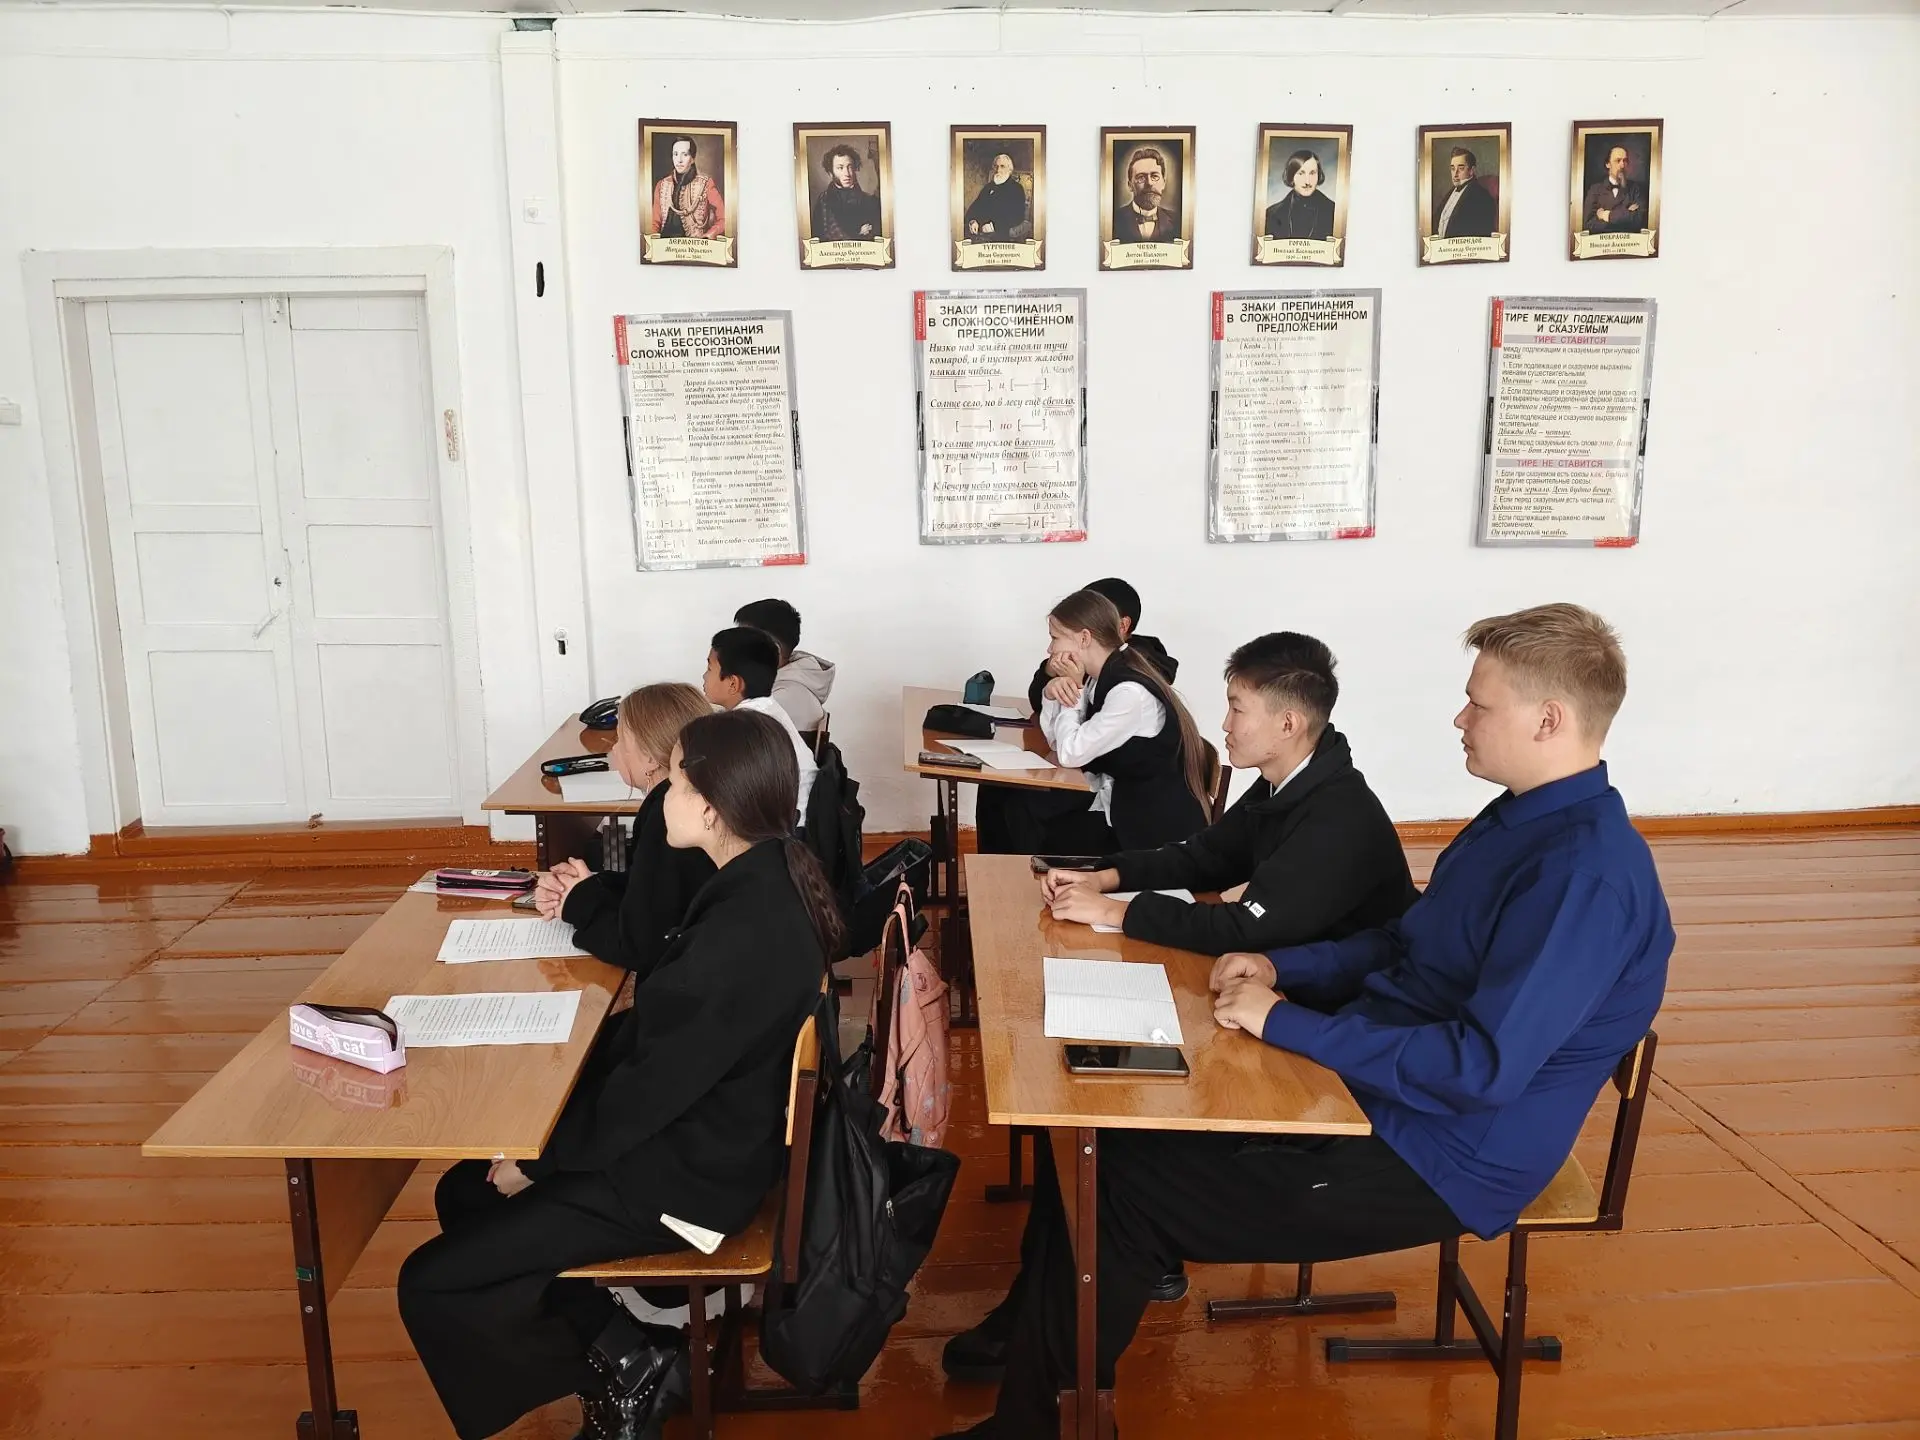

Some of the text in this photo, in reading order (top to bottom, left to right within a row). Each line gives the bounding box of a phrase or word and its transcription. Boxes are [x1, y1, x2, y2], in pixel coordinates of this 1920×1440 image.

[939, 304, 1062, 315] ЗНАКИ ПРЕПИНАНИЯ
[1241, 300, 1354, 311] ЗНАКИ ПРЕПИНАНИЯ
[928, 314, 1074, 327] В СЛОЖНОСОЧИНЁННОМ
[1227, 309, 1368, 323] В СЛОЖНОПОДЧИНЁННОМ
[1505, 313, 1644, 325] ТИРЕ МЕЖДУ ПОДЛЕЖАЩИМ
[644, 325, 764, 338] ЗНАКИ ПРЕПИНАНИЯ
[1256, 322, 1338, 333] ПРЕДЛОЖЕНИИ
[1536, 324, 1609, 334] И СКАЗУЕМЫМ
[957, 328, 1045, 339] ПРЕДЛОЖЕНИИ
[657, 336, 753, 348] В БЕССОЮЗНОМ
[1535, 335, 1607, 345] ТИРЕ СТАВИТСЯ
[630, 346, 781, 359] СЛОЖНОМ ПРЕДЛОЖЕНИИ
[929, 343, 956, 352] Низко
[958, 343, 975, 352] над
[929, 355, 970, 366] комаров,
[987, 355, 1033, 366] пустырях
[1034, 353, 1074, 362] жалобно
[930, 398, 961, 409] Солнце
[1517, 459, 1603, 468] ТИРЕ НЕ СТАВИТСЯ
[342, 1040, 366, 1056] cat
